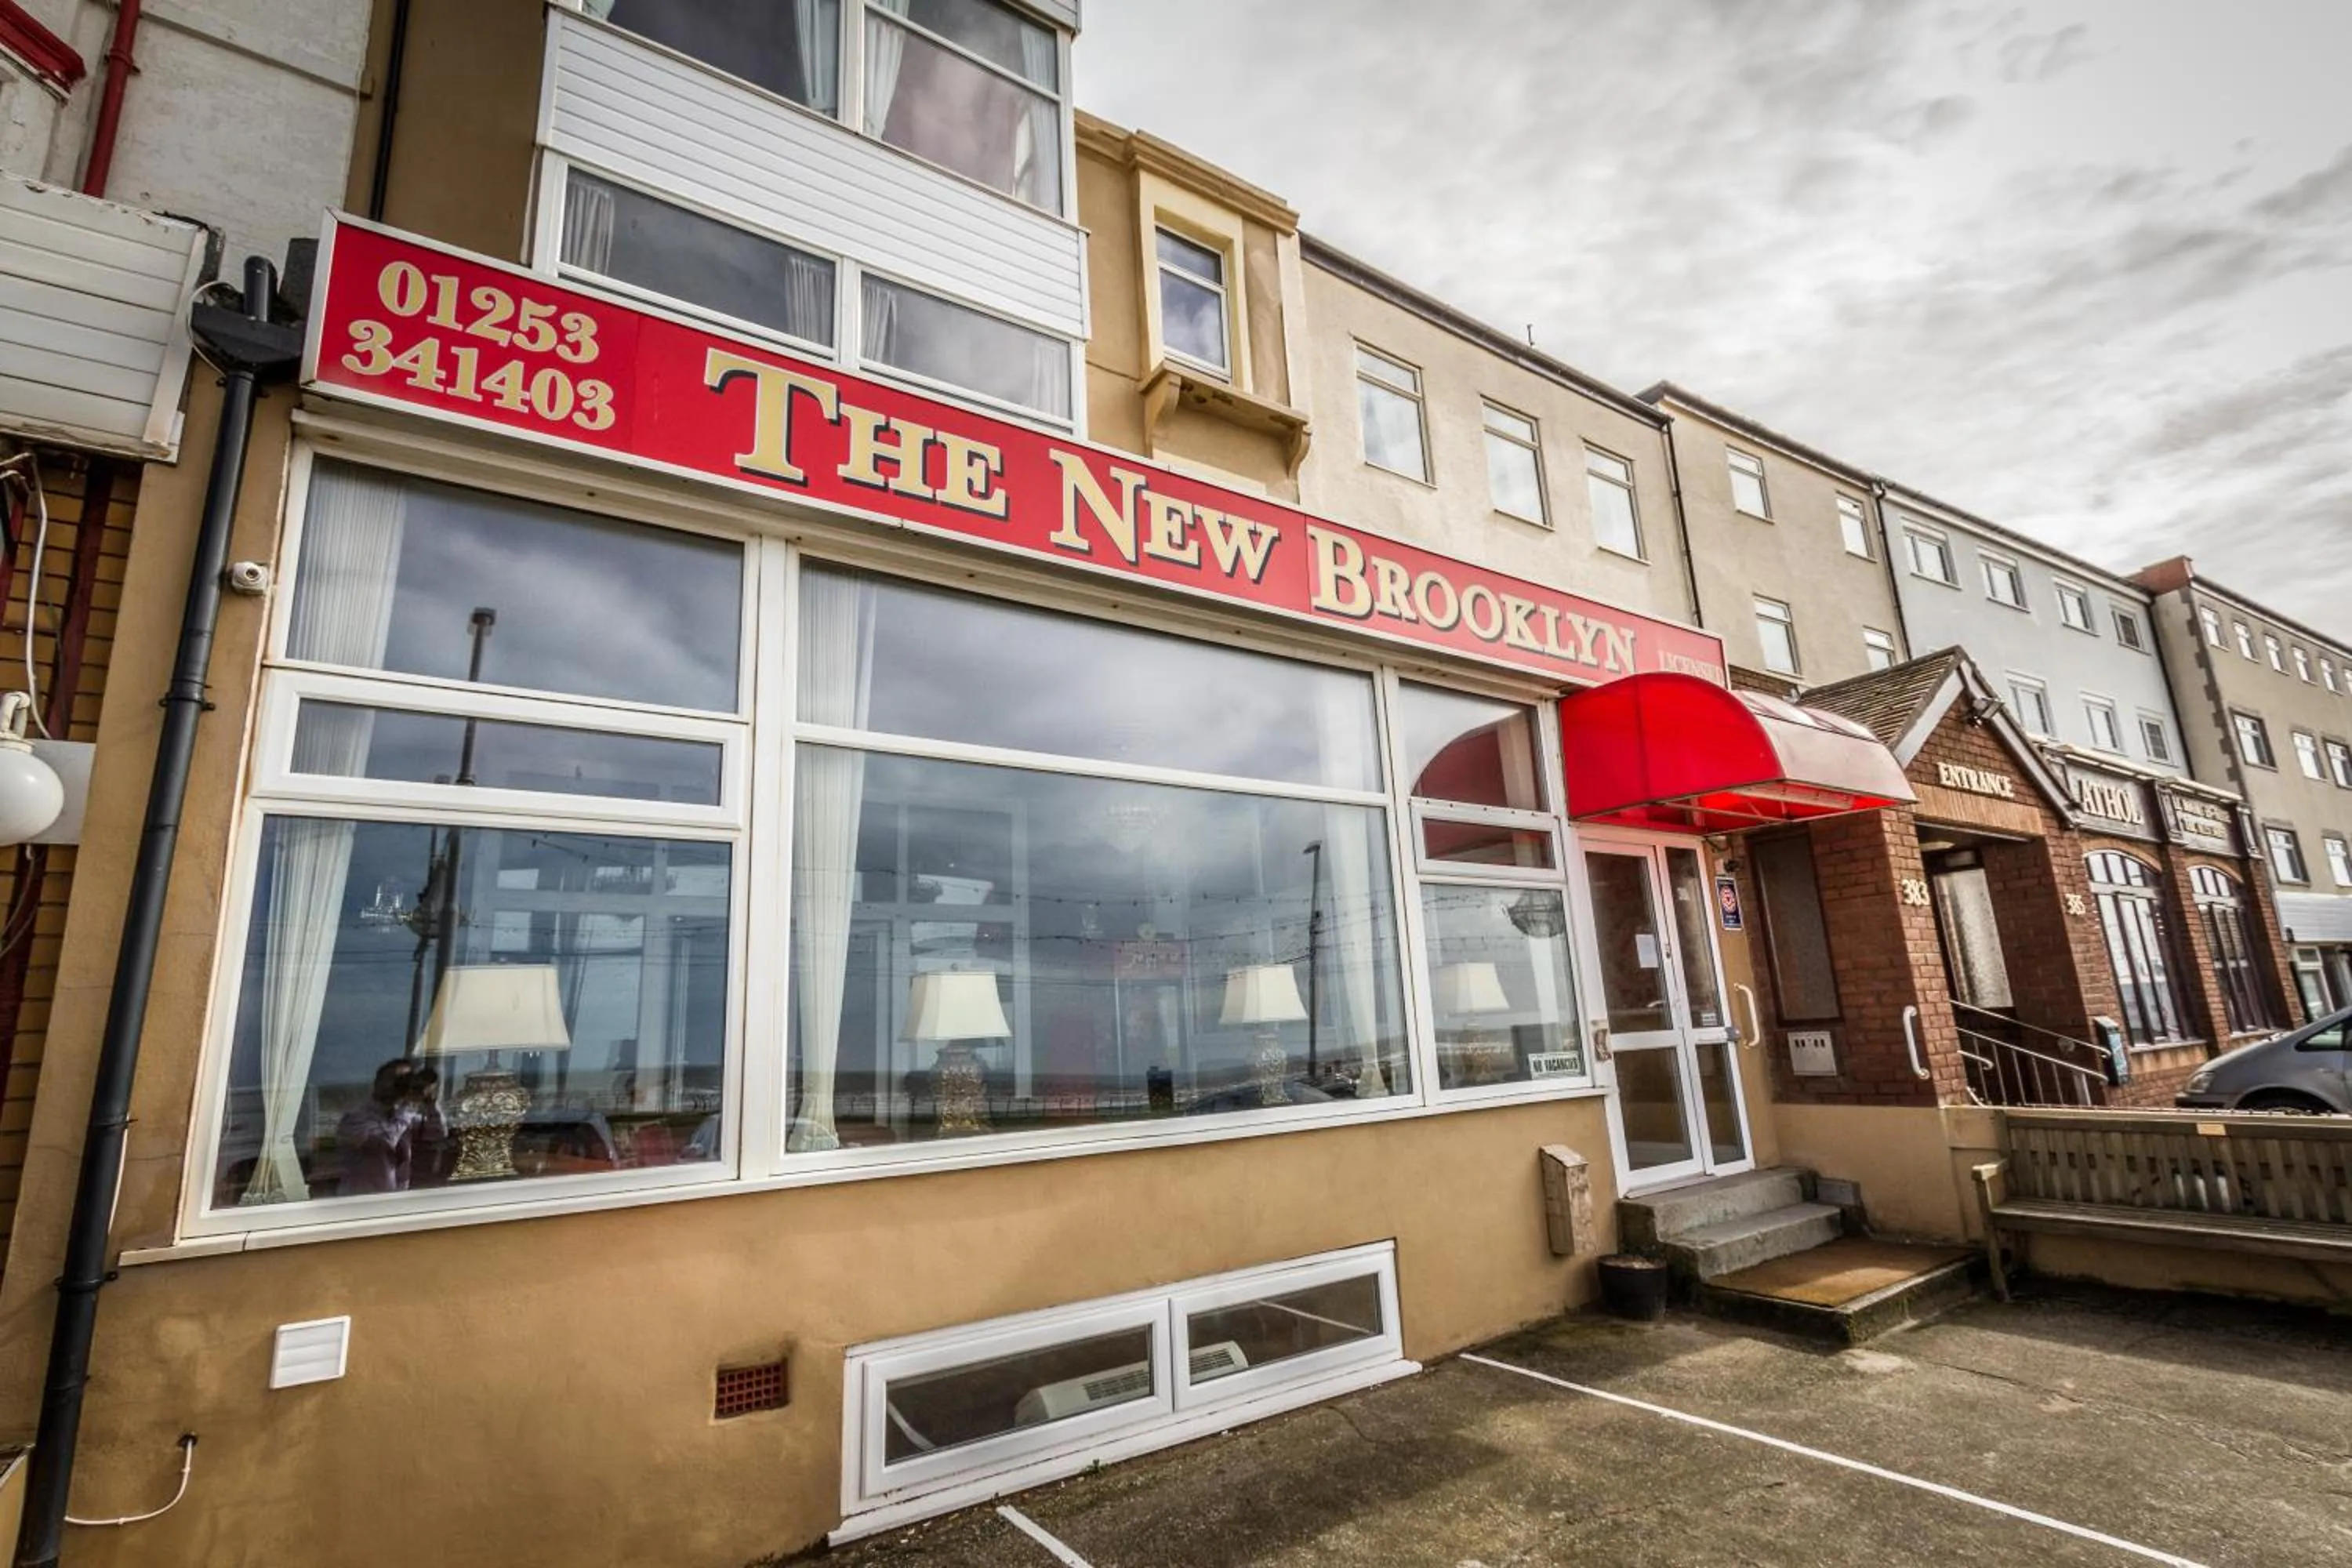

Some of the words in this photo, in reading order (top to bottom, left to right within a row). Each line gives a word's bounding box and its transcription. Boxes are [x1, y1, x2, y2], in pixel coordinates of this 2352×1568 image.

[377, 260, 600, 365] 01253
[341, 318, 616, 431] 341403
[703, 347, 1010, 521] THE
[1049, 448, 1281, 583] NEW
[1308, 524, 1635, 675] BROOKLYN
[1936, 761, 2015, 798] ENTRANCE
[1901, 878, 1931, 906] 383
